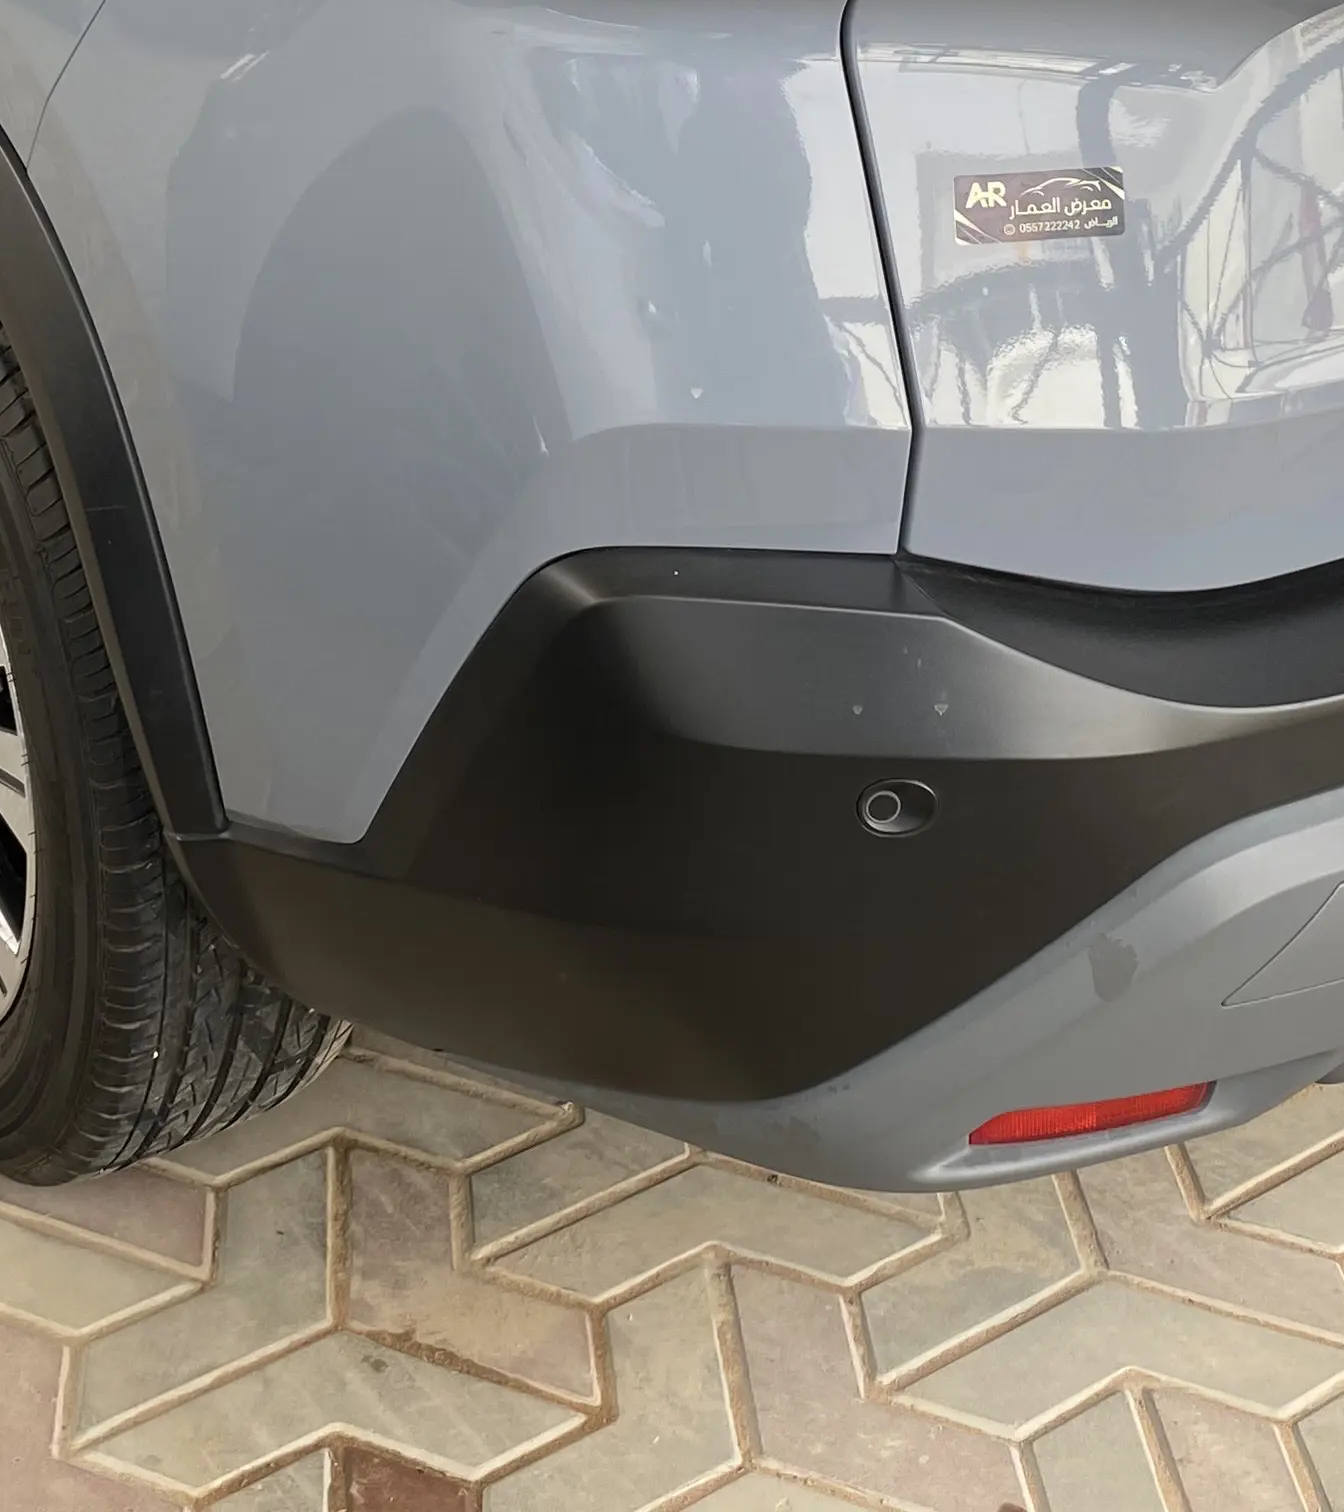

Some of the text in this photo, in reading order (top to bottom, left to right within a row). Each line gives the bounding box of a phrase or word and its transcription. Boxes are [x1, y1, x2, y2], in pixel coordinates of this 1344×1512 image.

[965, 181, 1007, 209] AR
[1009, 196, 1113, 220] معرض العمار
